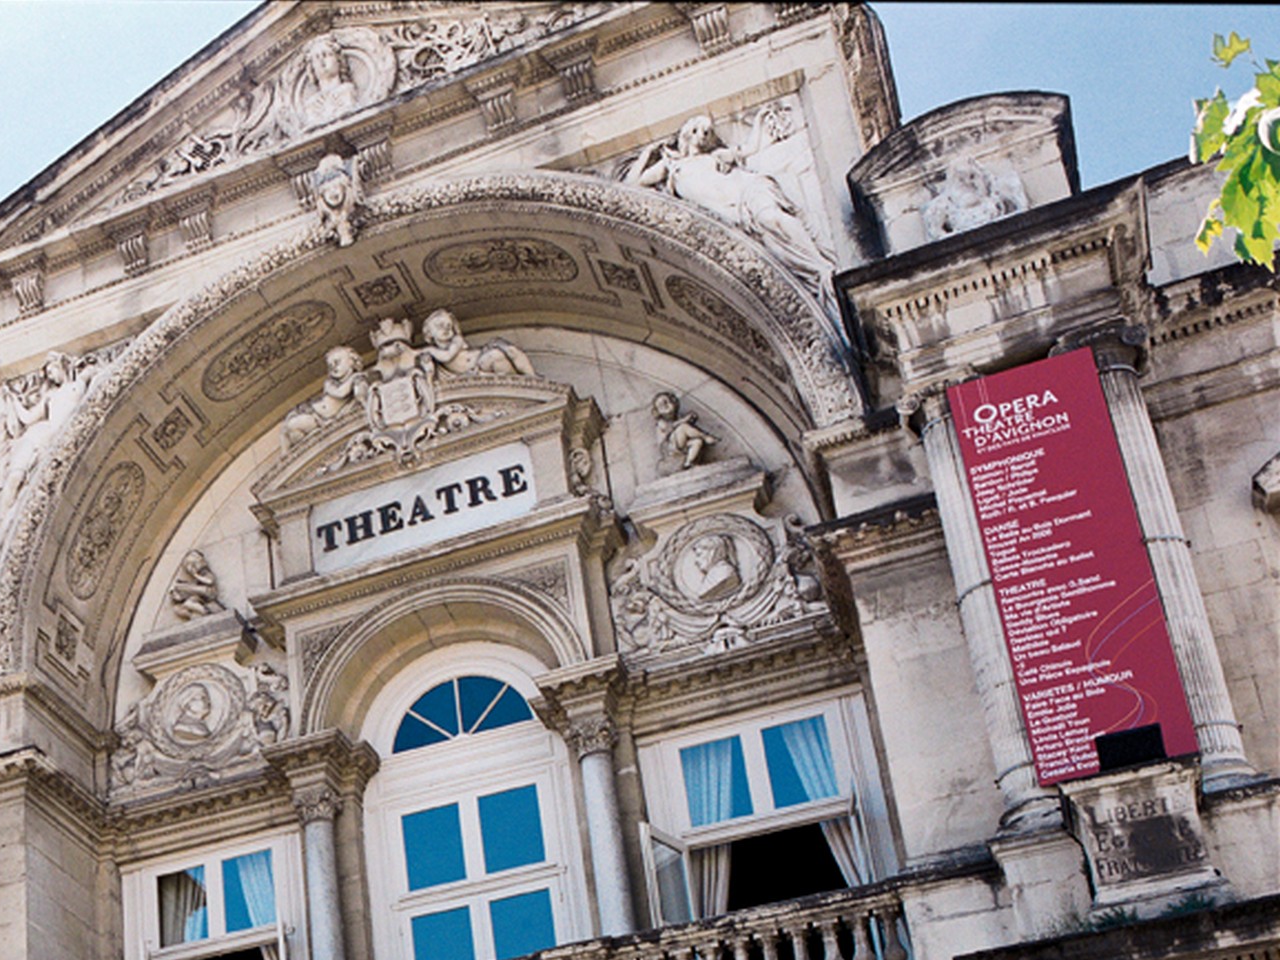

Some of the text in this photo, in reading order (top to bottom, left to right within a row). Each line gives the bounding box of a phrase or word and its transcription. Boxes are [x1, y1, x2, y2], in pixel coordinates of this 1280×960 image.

[973, 390, 1058, 424] OPERA
[962, 412, 1034, 438] THEATRE
[973, 412, 1069, 447] D'AVIGNON
[318, 465, 528, 552] THEATRE
[983, 518, 1019, 535] DANSE
[998, 578, 1046, 597] THEATRE
[1082, 669, 1133, 688] HUMOUR
